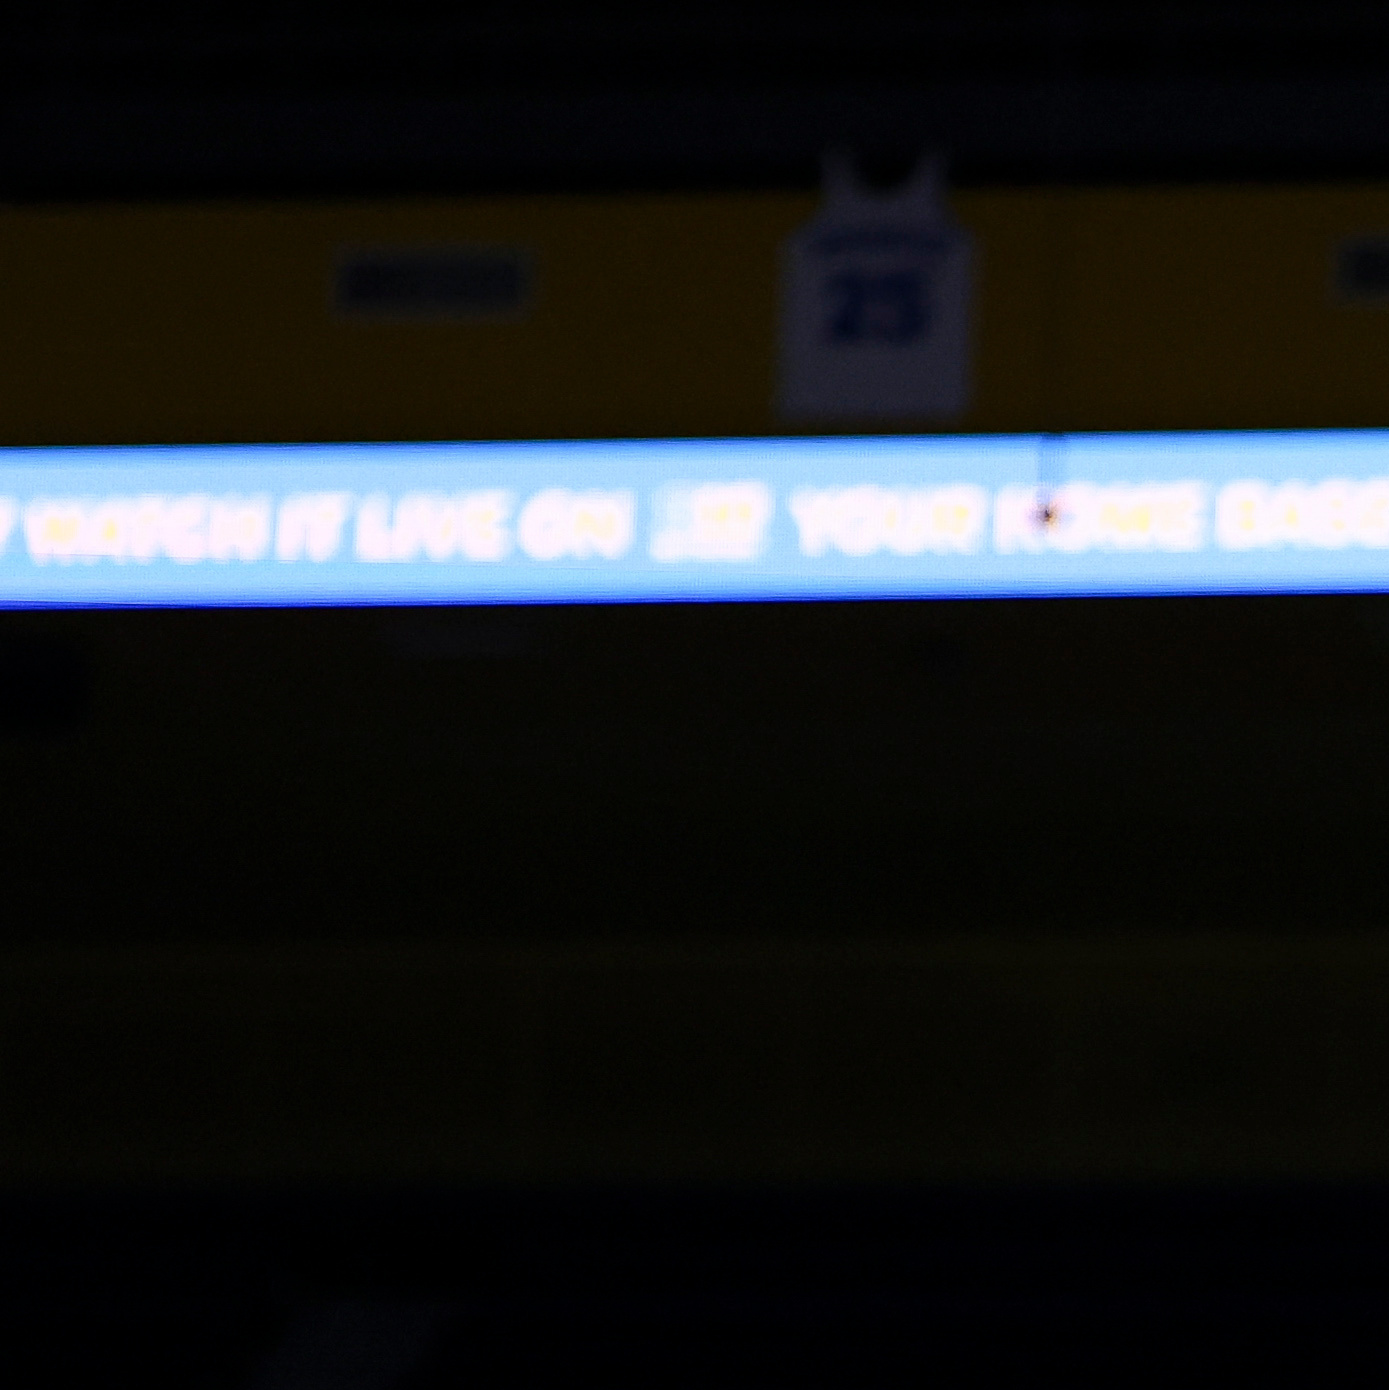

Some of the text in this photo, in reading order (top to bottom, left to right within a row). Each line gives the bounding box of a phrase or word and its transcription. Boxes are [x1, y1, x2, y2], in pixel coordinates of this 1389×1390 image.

[355, 490, 510, 560] LIVE
[518, 489, 634, 559] ON
[790, 484, 988, 555] YOUR
